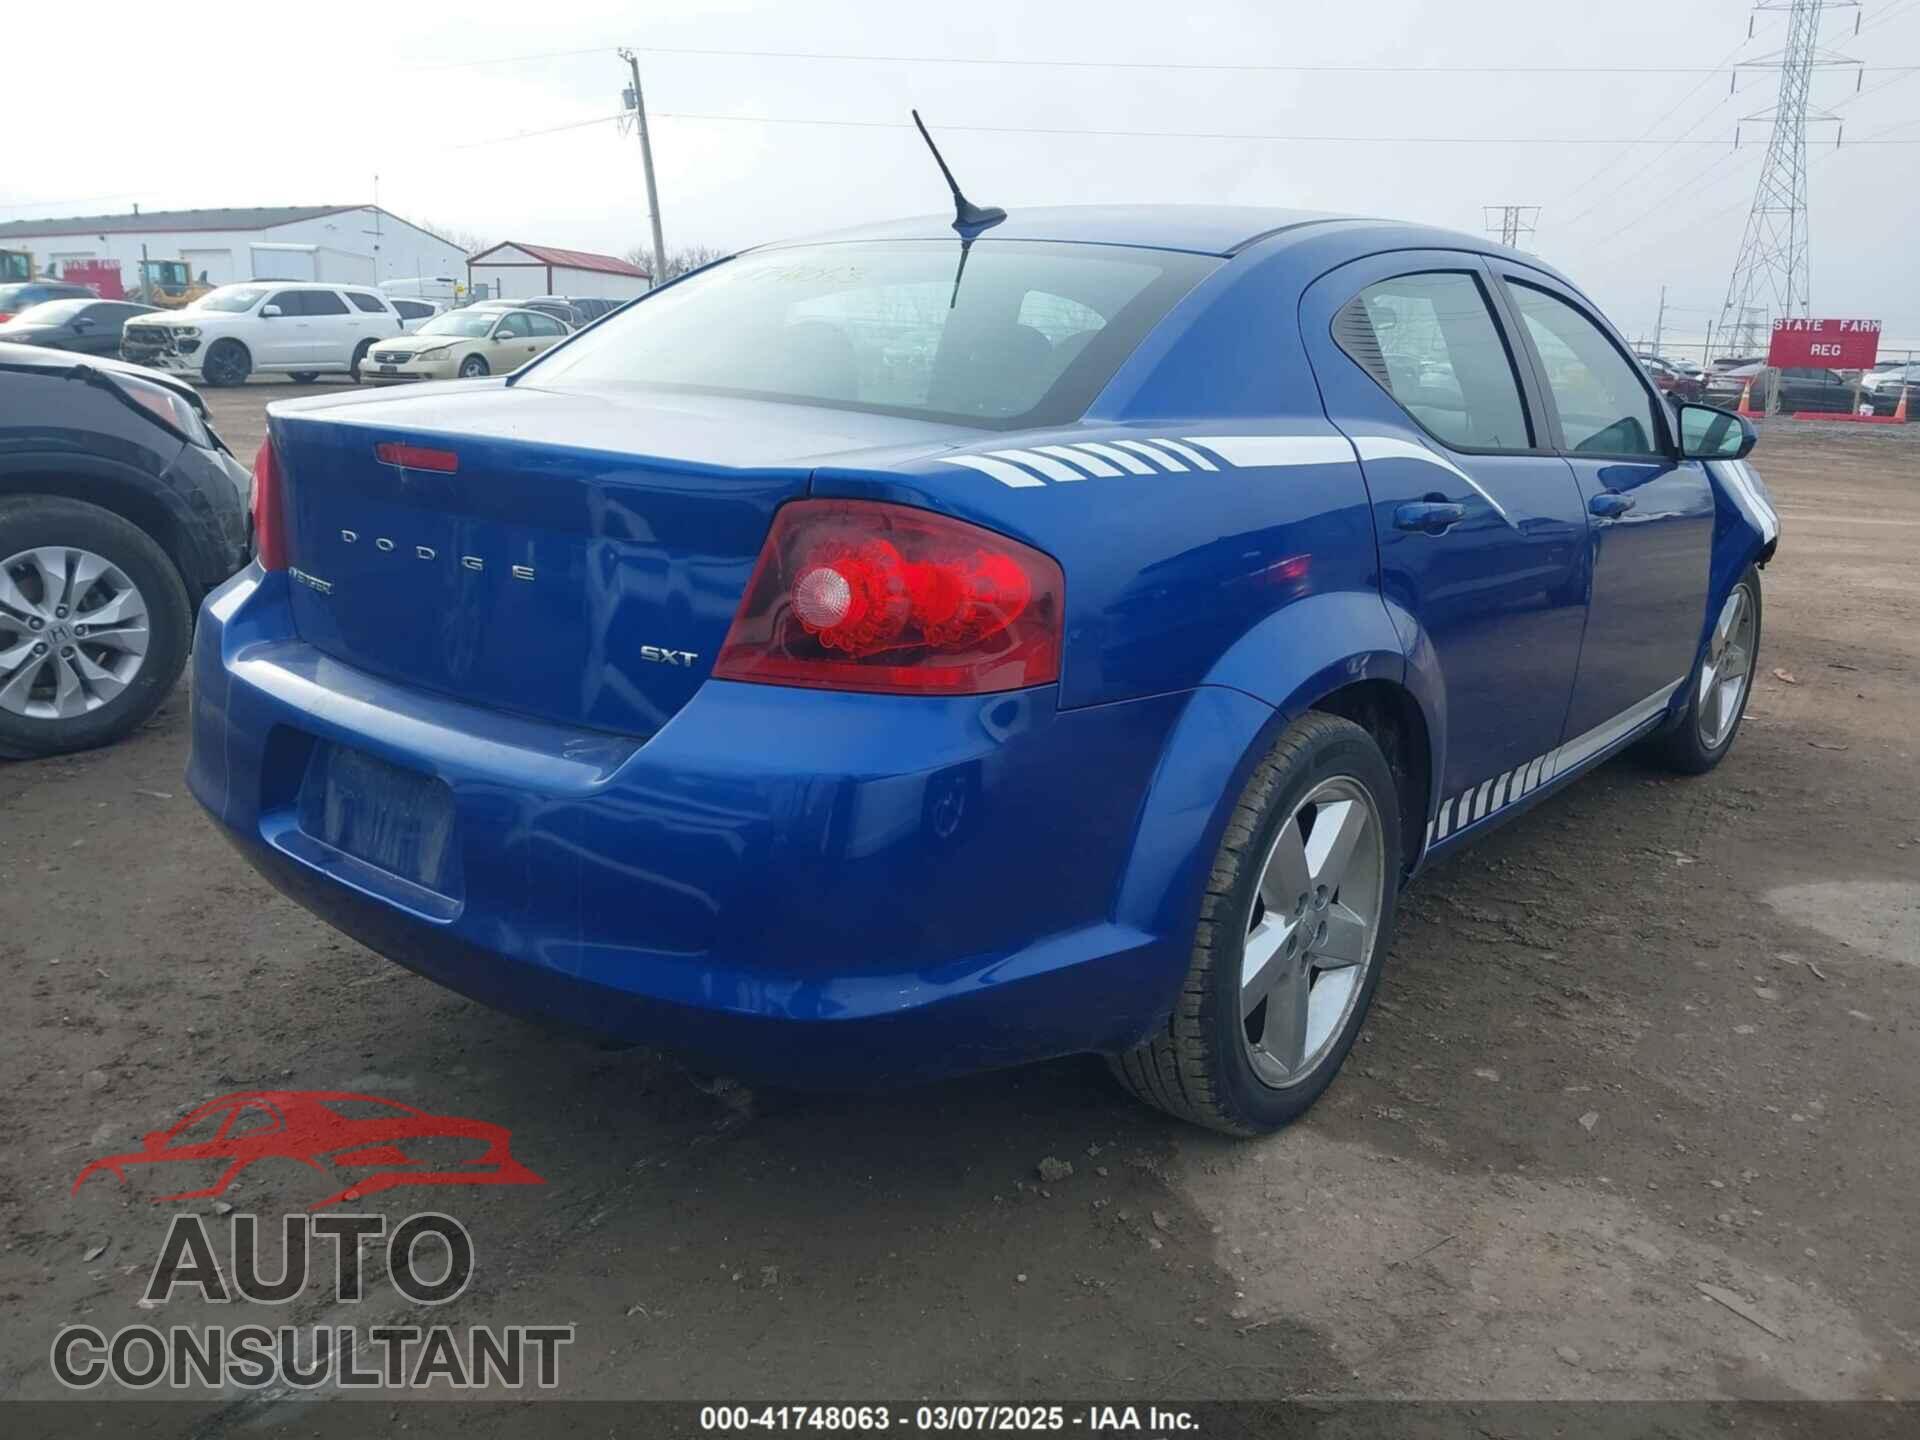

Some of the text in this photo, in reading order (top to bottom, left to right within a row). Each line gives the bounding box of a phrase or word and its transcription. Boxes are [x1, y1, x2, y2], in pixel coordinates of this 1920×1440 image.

[1774, 319, 1881, 333] STATE FARM
[1810, 343, 1842, 357] REG
[341, 529, 535, 581] DODGE
[640, 645, 699, 667] SXT
